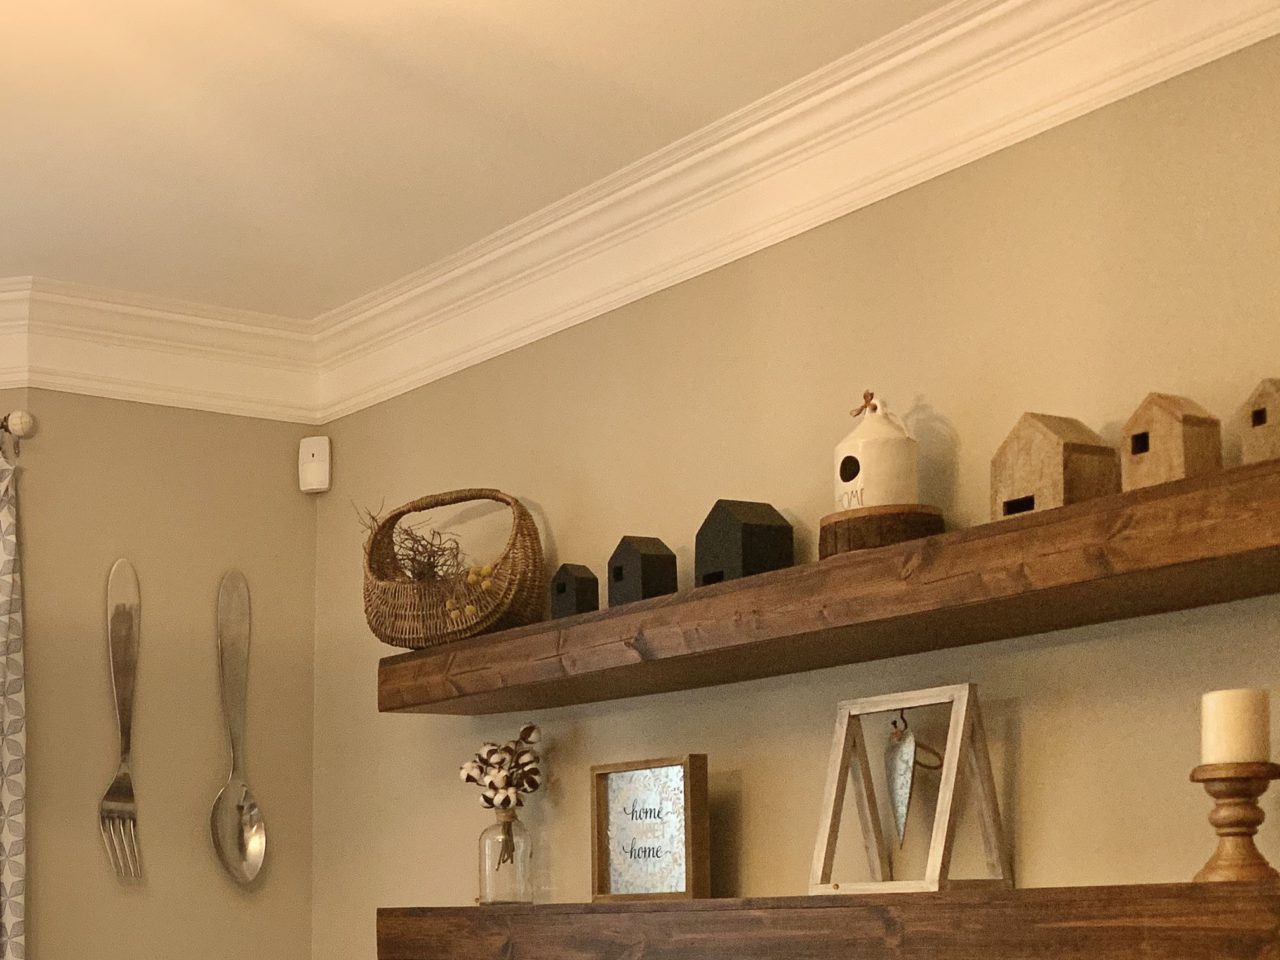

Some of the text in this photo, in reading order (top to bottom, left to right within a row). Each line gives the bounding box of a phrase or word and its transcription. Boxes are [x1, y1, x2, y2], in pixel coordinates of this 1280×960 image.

[837, 487, 865, 510] OME
[623, 798, 672, 821] home
[622, 836, 671, 860] home
